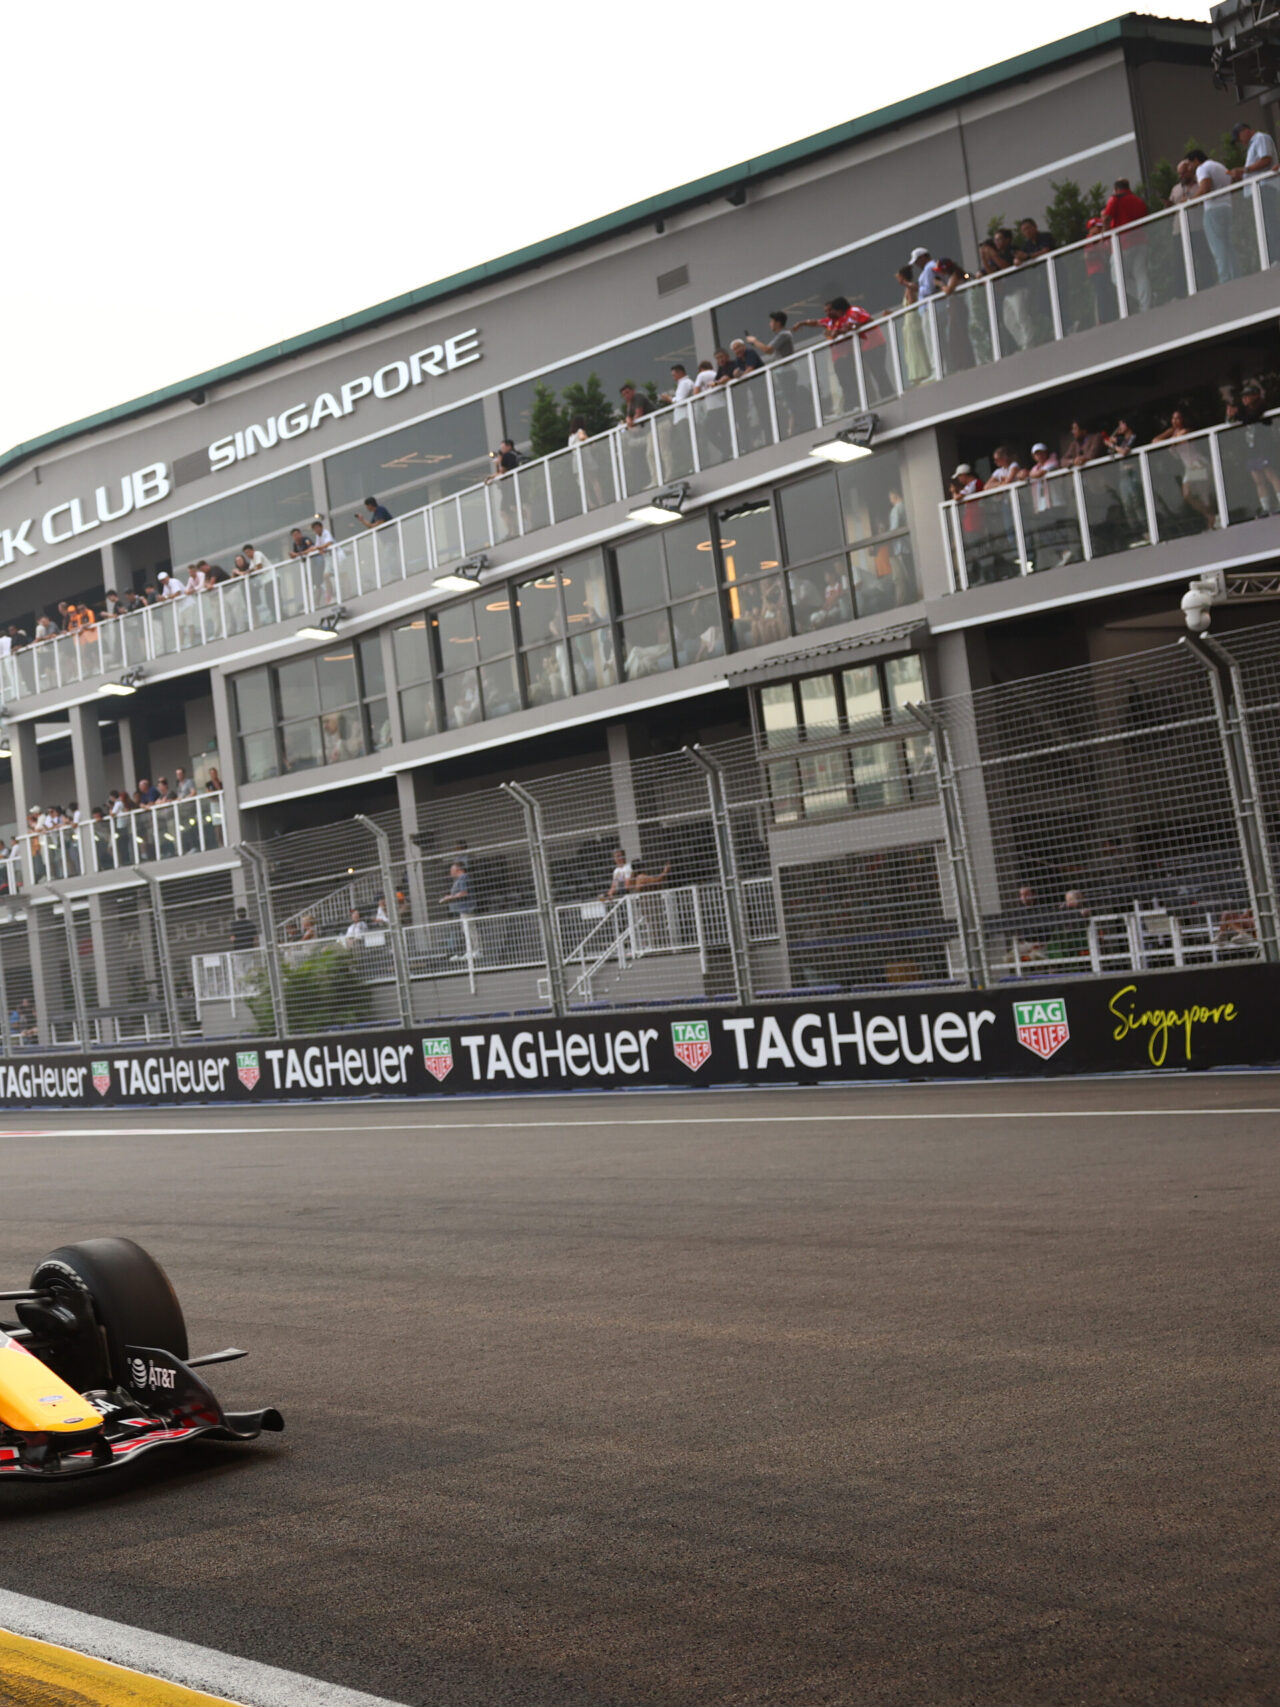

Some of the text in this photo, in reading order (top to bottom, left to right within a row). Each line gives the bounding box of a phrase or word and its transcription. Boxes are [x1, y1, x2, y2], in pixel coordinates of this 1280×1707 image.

[42, 462, 171, 545] CLUB
[208, 328, 481, 471] SINGAPORE
[1019, 1002, 1063, 1022] TAG
[674, 1023, 708, 1042] TAG
[1109, 985, 1238, 1066] Singapore
[424, 1039, 451, 1055] TAG
[1019, 1025, 1069, 1057] HEUER
[674, 1044, 711, 1068] HEUER
[149, 1366, 176, 1389] AT&T
